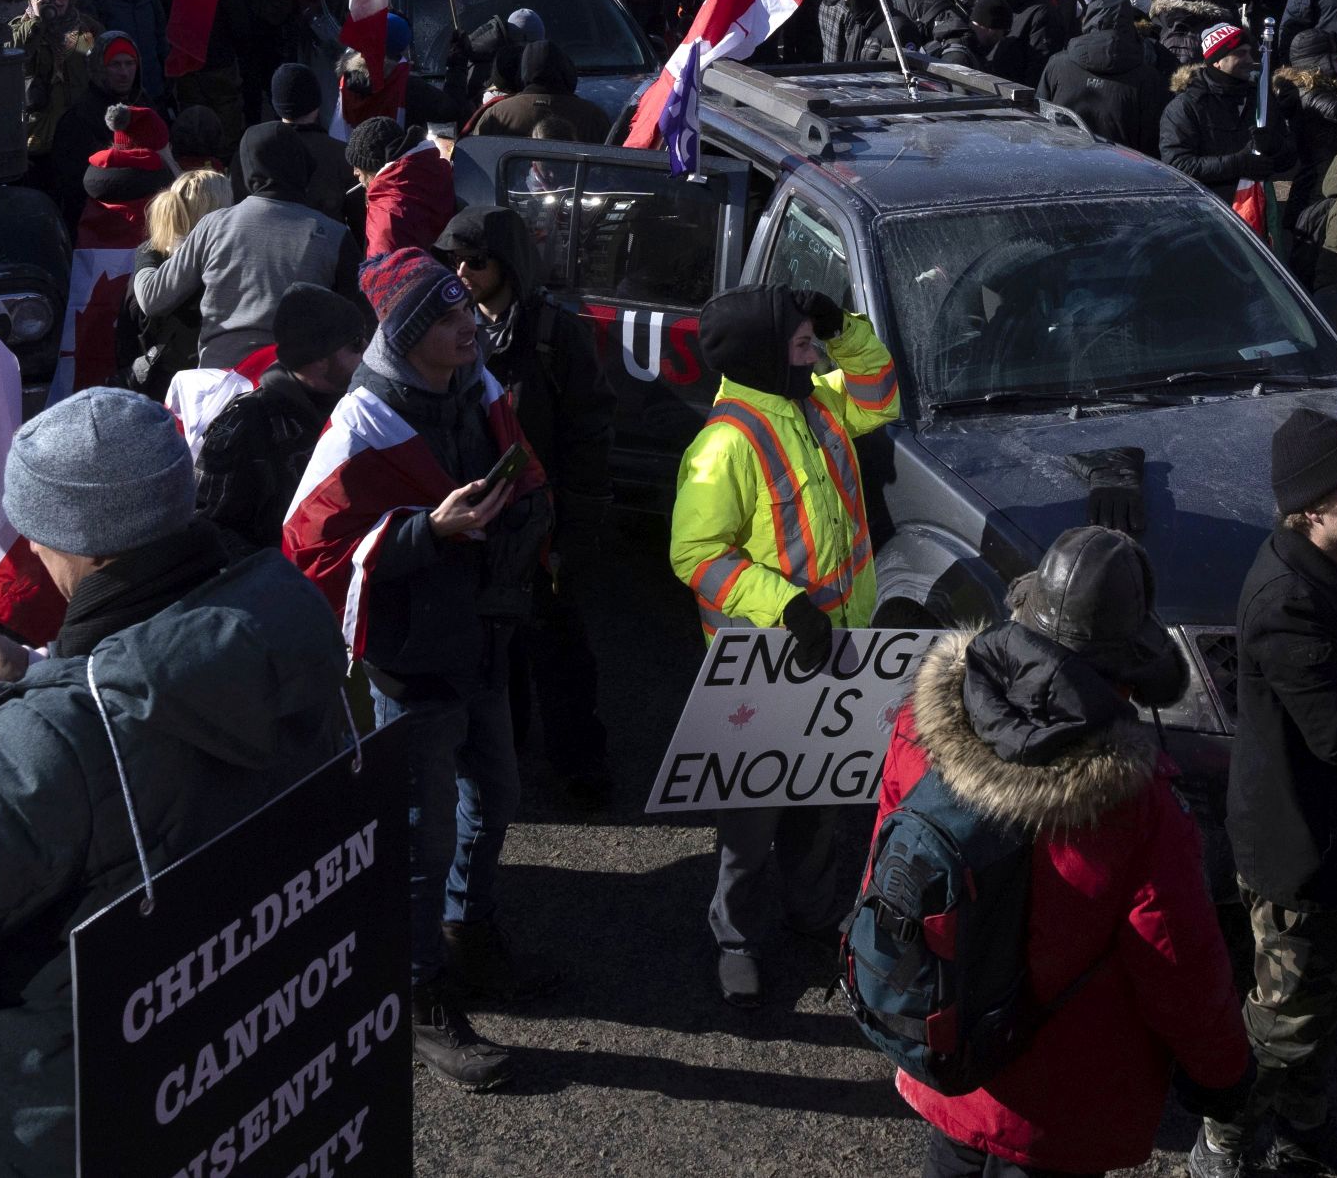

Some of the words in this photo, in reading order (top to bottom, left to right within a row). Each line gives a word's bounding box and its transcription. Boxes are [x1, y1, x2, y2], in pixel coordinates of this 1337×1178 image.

[788, 218, 804, 242] We
[802, 686, 864, 738] IS
[122, 819, 378, 1045] CHILDREN
[154, 930, 356, 1126] CANNOT
[347, 993, 400, 1067] TO
